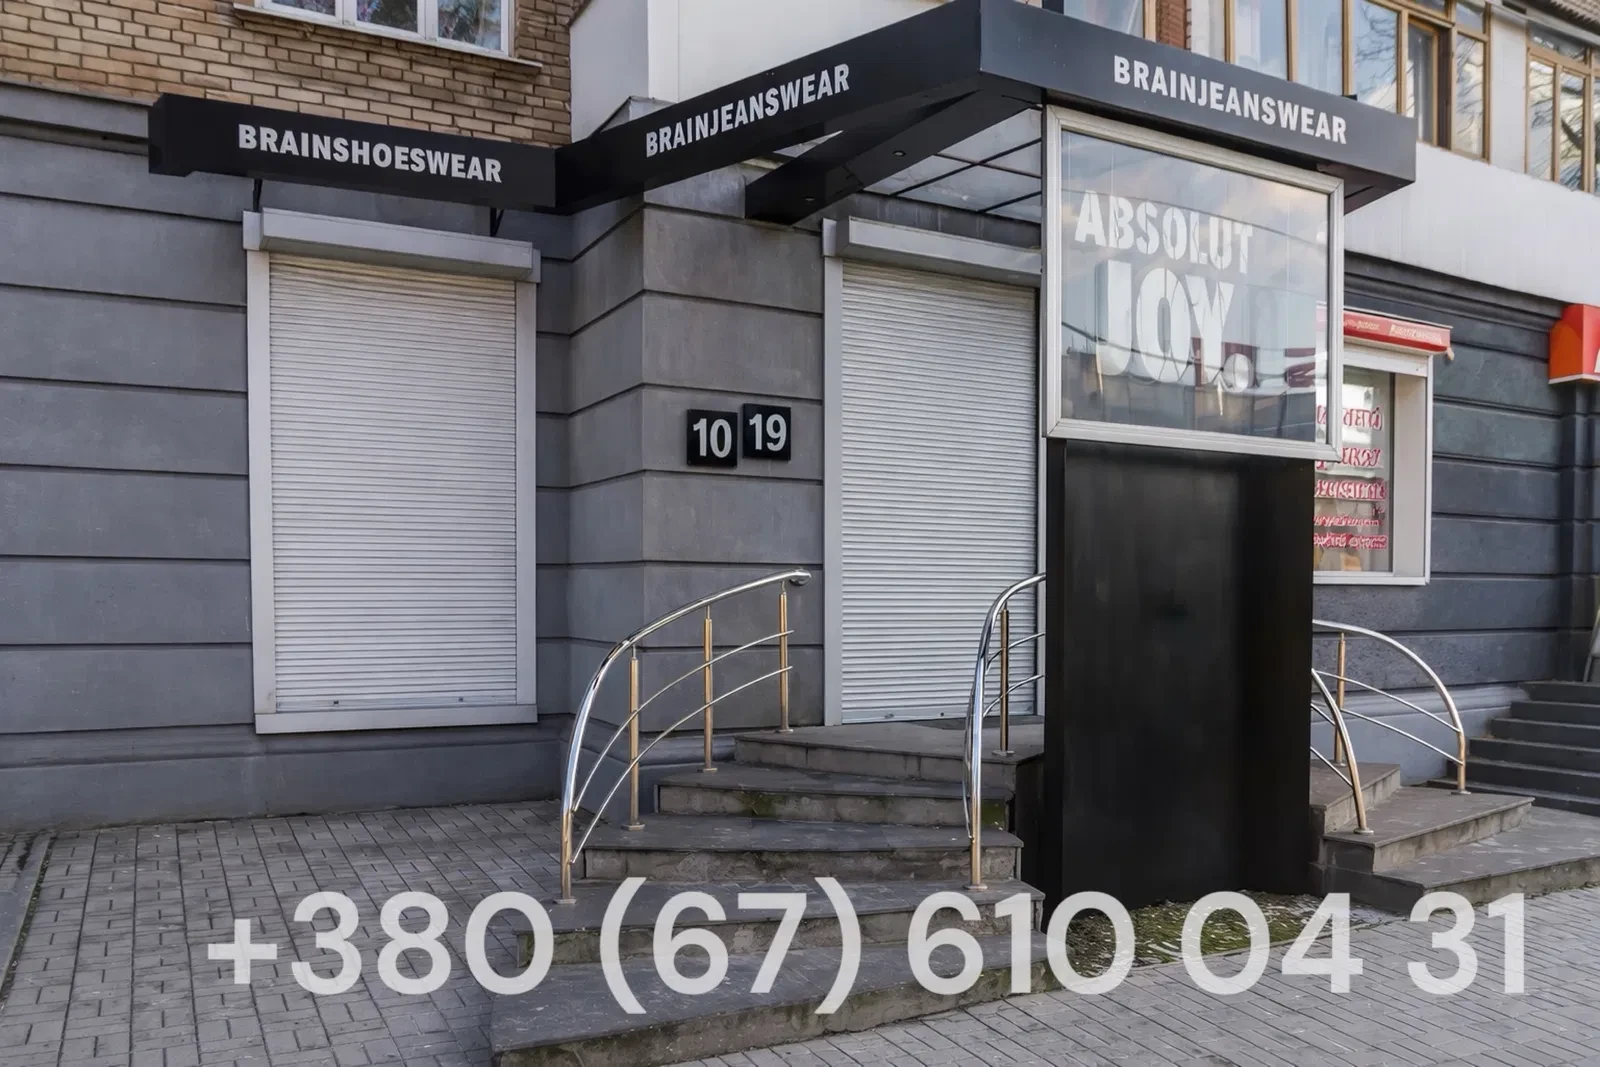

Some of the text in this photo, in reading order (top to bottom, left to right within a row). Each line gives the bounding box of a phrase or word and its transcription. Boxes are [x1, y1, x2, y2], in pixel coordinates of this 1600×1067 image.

[644, 63, 851, 158] BRAINJEANSWEAR
[1112, 54, 1348, 145] BRAINJEANSWEAR
[237, 123, 503, 185] BRAINSHOESWEAR
[1074, 189, 1253, 275] ABSOLUT
[692, 417, 732, 458] 10
[748, 413, 787, 452] 19
